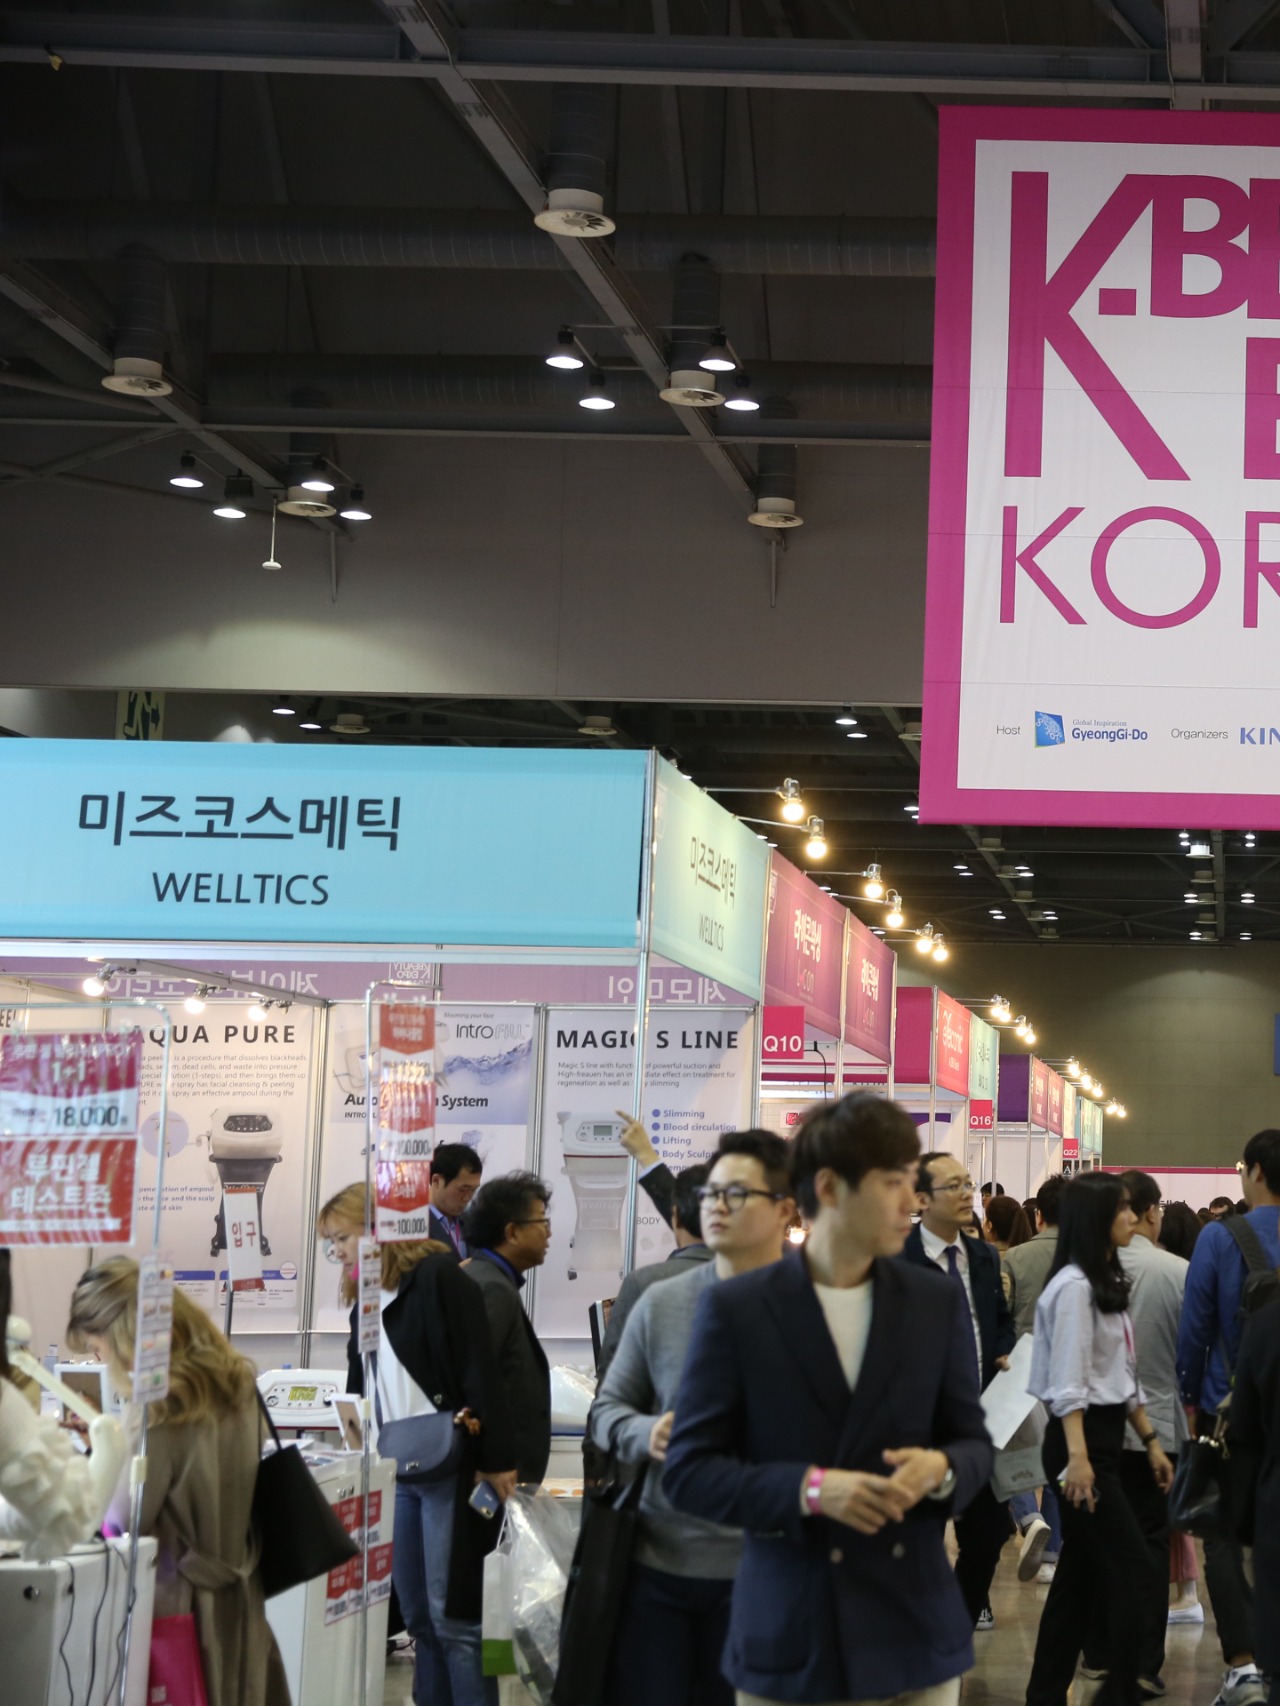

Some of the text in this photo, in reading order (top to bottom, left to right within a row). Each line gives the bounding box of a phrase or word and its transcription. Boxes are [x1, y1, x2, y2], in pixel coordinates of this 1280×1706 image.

[1072, 719, 1127, 729] Global Inspiration
[996, 724, 1021, 736] Host
[1170, 728, 1229, 741] Organizers
[1072, 728, 1148, 743] GyeongGi-Do
[78, 791, 402, 851] 미즈코스메틱
[690, 835, 737, 910] 미즈코스메틱
[153, 872, 329, 905] WELLTICS
[224, 1025, 295, 1043] PURE
[656, 1030, 669, 1049] S
[681, 1031, 738, 1048] LINE
[763, 1035, 802, 1053] Q10
[187, 1055, 221, 1063] procedure
[269, 1064, 297, 1072] pressure
[558, 1062, 578, 1070] Magic
[652, 1062, 682, 1070] powerful
[140, 1072, 162, 1080] pecial
[256, 1072, 277, 1080] brings
[229, 1081, 260, 1089] cleansing
[270, 1081, 294, 1089] peeling
[650, 1080, 680, 1088] slimming
[232, 1090, 258, 1098] ampoul
[259, 1090, 281, 1098] during
[344, 1094, 378, 1106] Auo
[441, 1095, 488, 1110] System
[663, 1110, 705, 1119] Slimming
[970, 1115, 991, 1126] Q16
[663, 1123, 737, 1131] Blood circulation
[663, 1137, 691, 1146] Lifting
[662, 1150, 685, 1160] Body
[188, 1186, 214, 1194] ampoul
[198, 1195, 215, 1203] scalp
[636, 1217, 660, 1225] BODY
[231, 1221, 256, 1248] 입구
